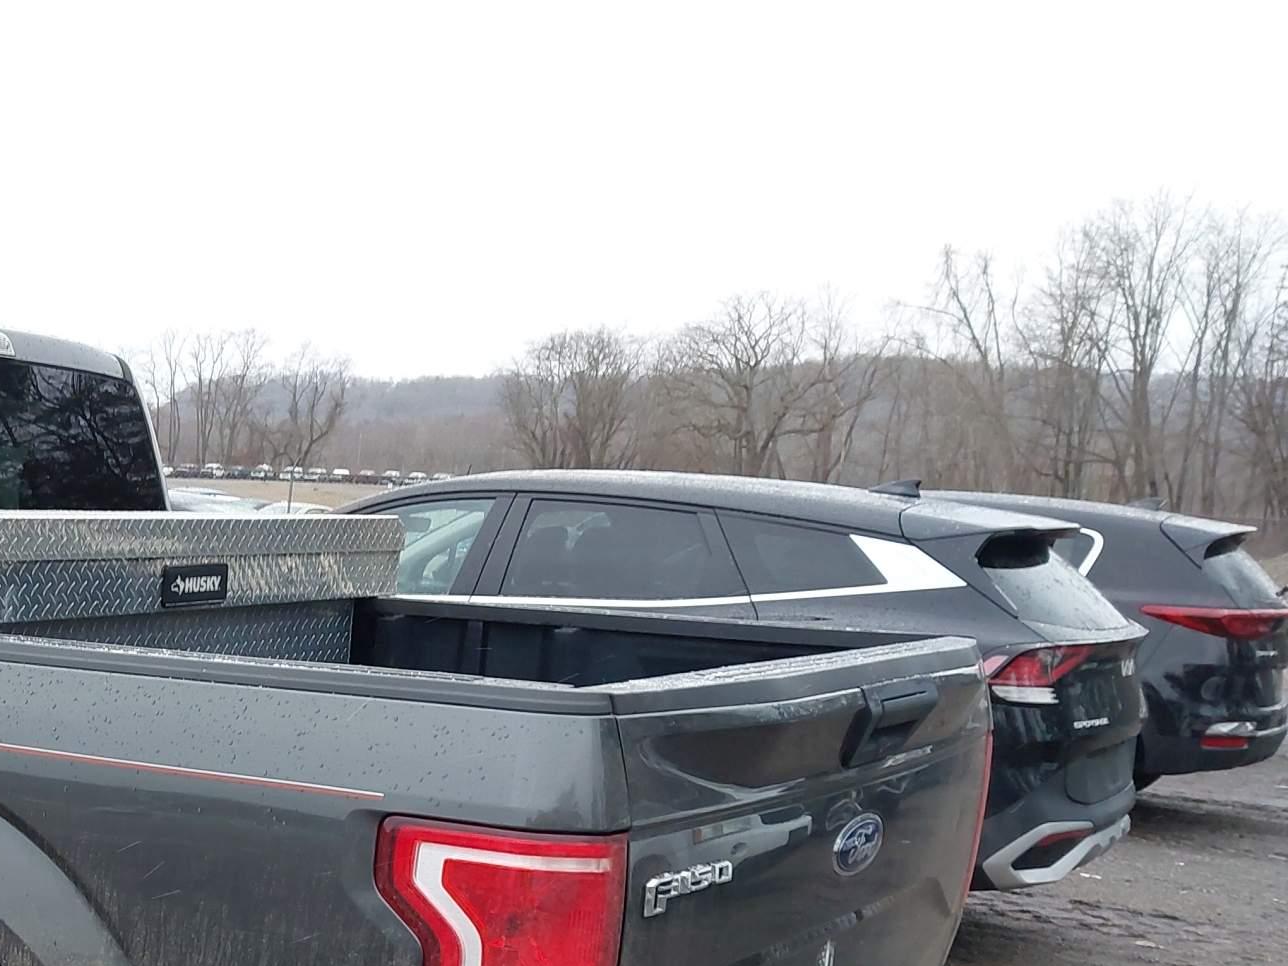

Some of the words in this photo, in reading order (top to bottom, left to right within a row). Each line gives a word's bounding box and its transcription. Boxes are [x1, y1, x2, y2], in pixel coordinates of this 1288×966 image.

[184, 575, 221, 593] HUSKY
[842, 824, 878, 865] Ford
[644, 861, 732, 917] F150
